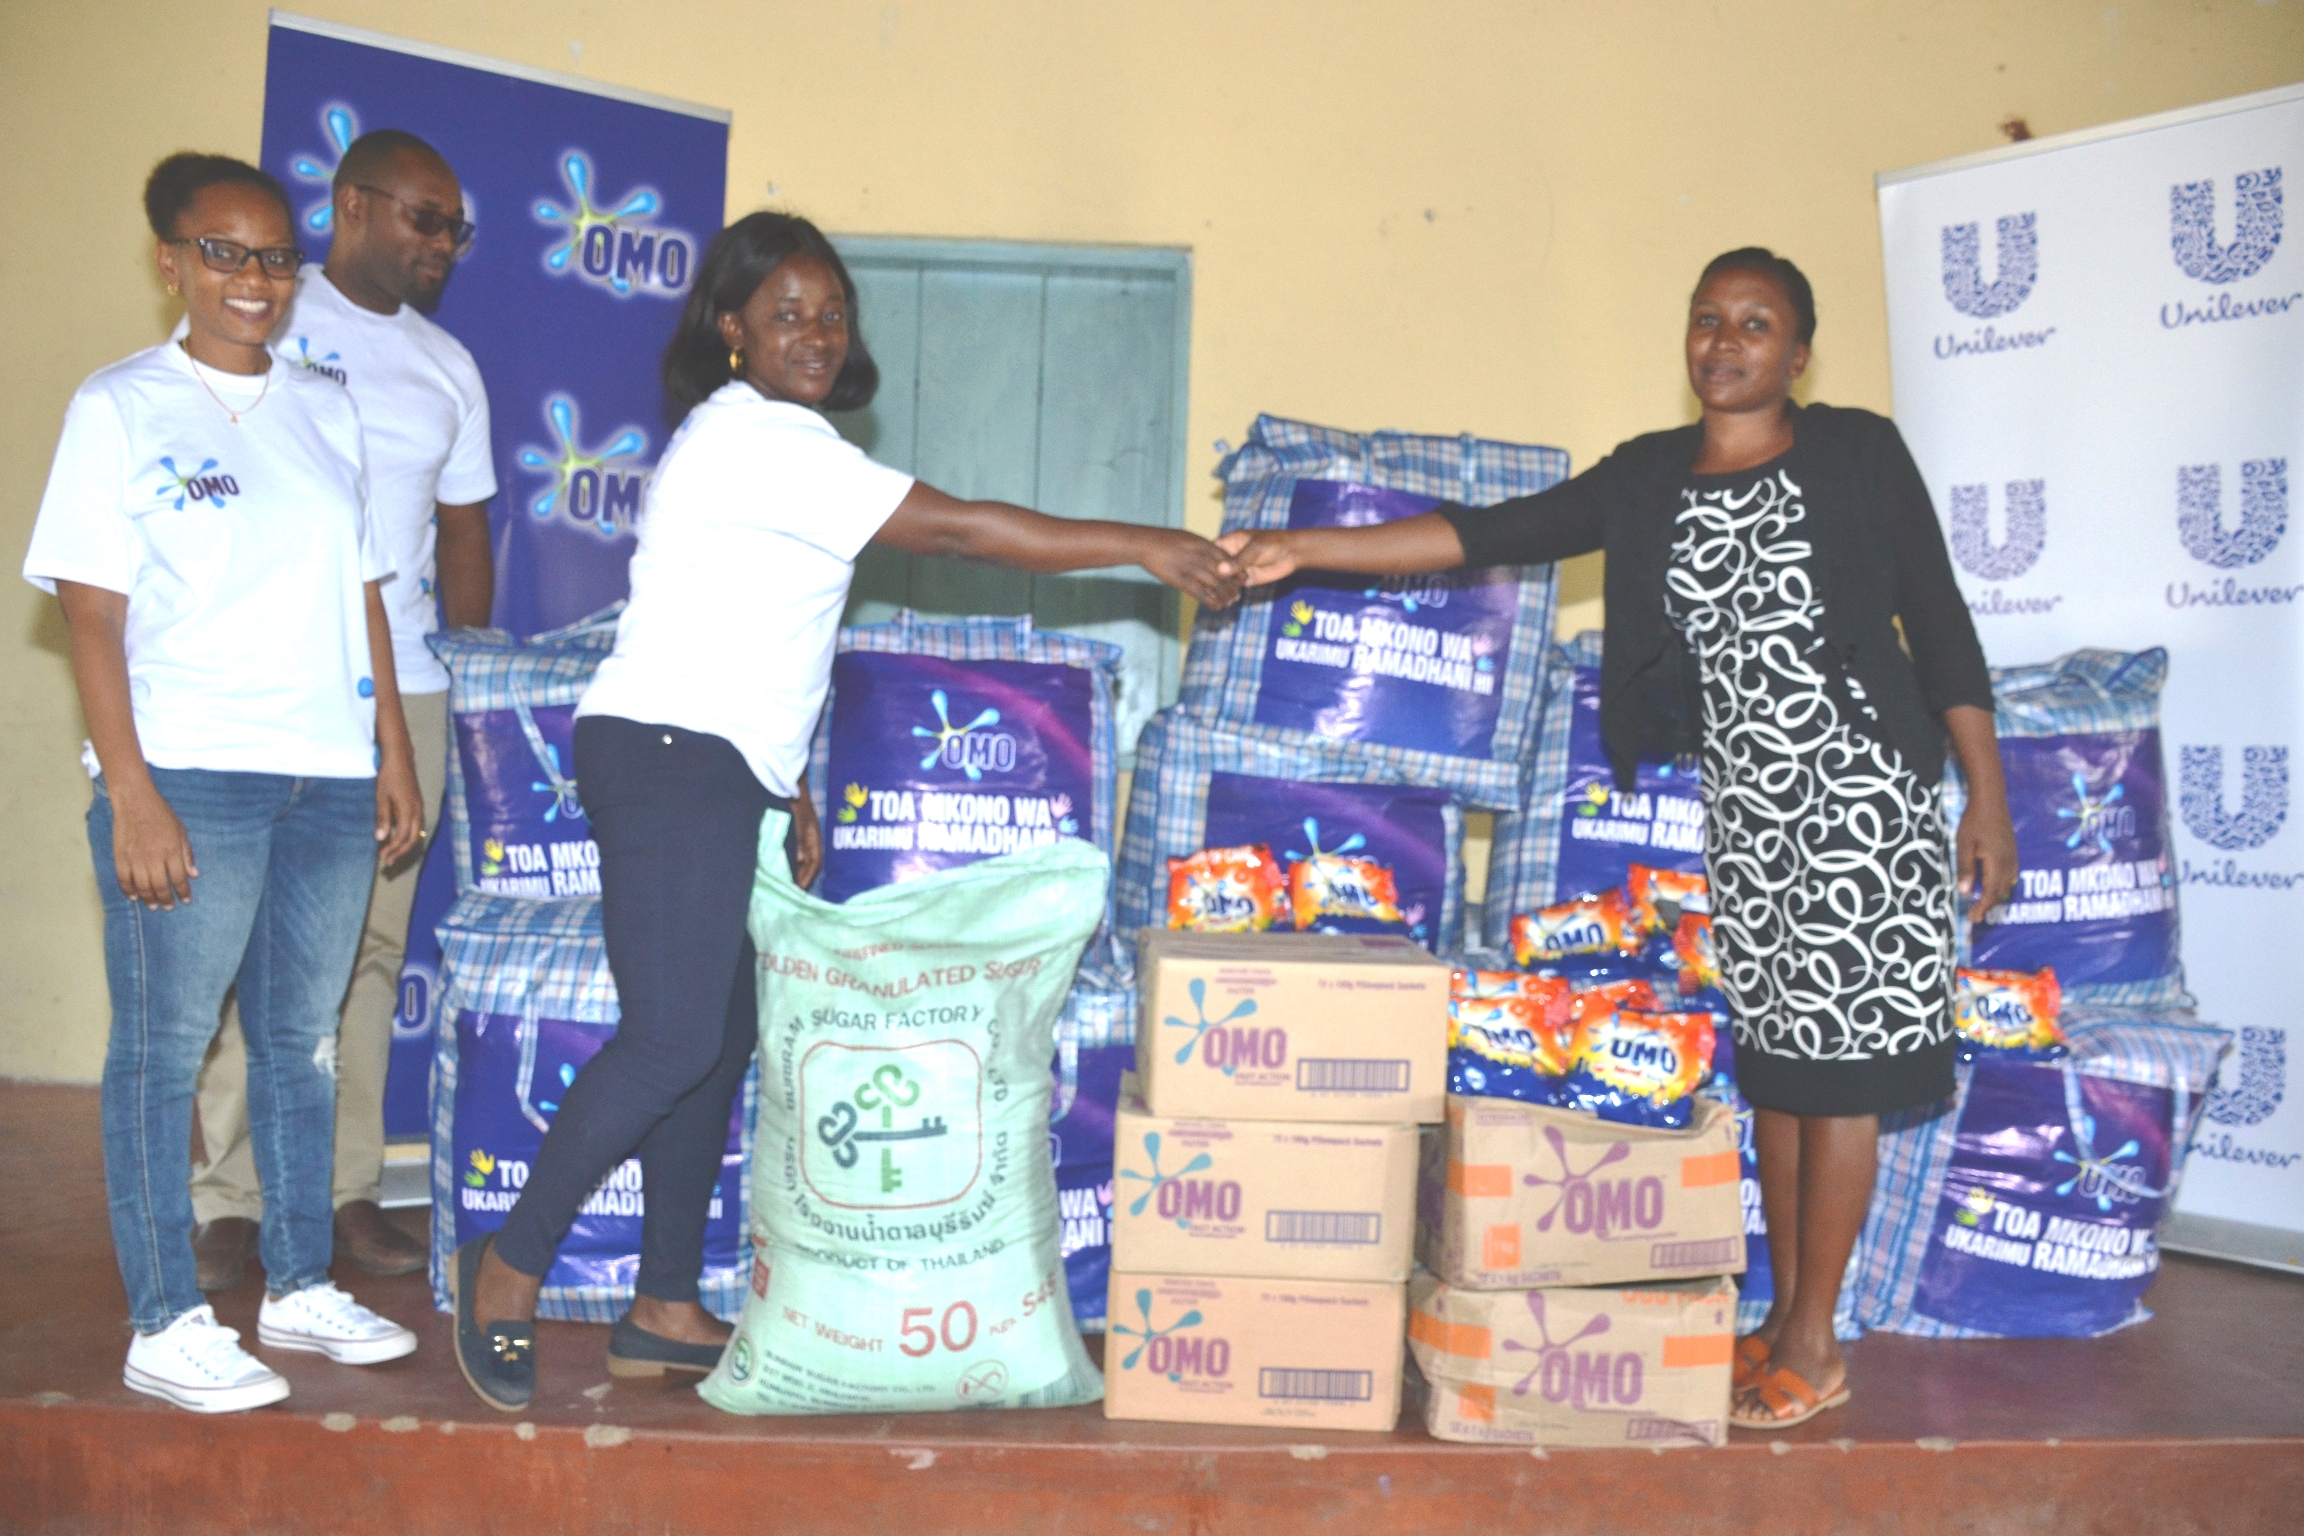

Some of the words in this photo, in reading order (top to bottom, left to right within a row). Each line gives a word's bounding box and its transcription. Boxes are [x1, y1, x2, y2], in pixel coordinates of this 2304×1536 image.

[583, 224, 687, 288] OMO
[2160, 291, 2302, 330] Unilever
[1934, 325, 2056, 360] Unilever
[186, 473, 240, 500] OMO
[569, 468, 648, 524] OM
[1967, 588, 2063, 615] nilever
[2165, 576, 2304, 609] Unilever
[1314, 610, 1354, 642] TOA
[1359, 618, 1439, 657] MKONO
[1441, 631, 1473, 664] WA
[1351, 644, 1474, 692] RAMADHANI
[942, 732, 1016, 772] OMO
[869, 790, 916, 822] TOA
[921, 792, 1010, 825] MKONO
[1014, 797, 1052, 827] WA
[1609, 791, 1652, 821] TOA
[1656, 794, 1704, 829] MKO
[833, 826, 913, 850] UKARIMU
[1572, 817, 1649, 846] UKARIMU
[505, 843, 549, 874] TOA
[550, 839, 600, 869] MKO
[2020, 868, 2064, 899] TOA
[2068, 861, 2136, 894] MKONO
[825, 964, 977, 1000] GRANULATED
[811, 1008, 877, 1031] SUGAR
[886, 1003, 985, 1030] FACTORY
[1203, 1027, 1287, 1069] OMO
[2193, 1133, 2301, 1168] nilever
[497, 1160, 530, 1188] TO
[1157, 1178, 1242, 1222] OMO
[1564, 1176, 1664, 1234] OMO
[1944, 1223, 2032, 1267] UKARIMU
[1993, 1200, 2042, 1240] TOA
[2042, 1216, 2131, 1255] MKONO
[886, 1258, 908, 1272] OF
[922, 1238, 1005, 1271] THAILAND
[783, 1305, 809, 1329] NET
[815, 1320, 884, 1352] WEIGHT
[899, 1299, 978, 1358] 50
[1147, 1335, 1230, 1377] OMO
[1540, 1350, 1643, 1405] OMO
